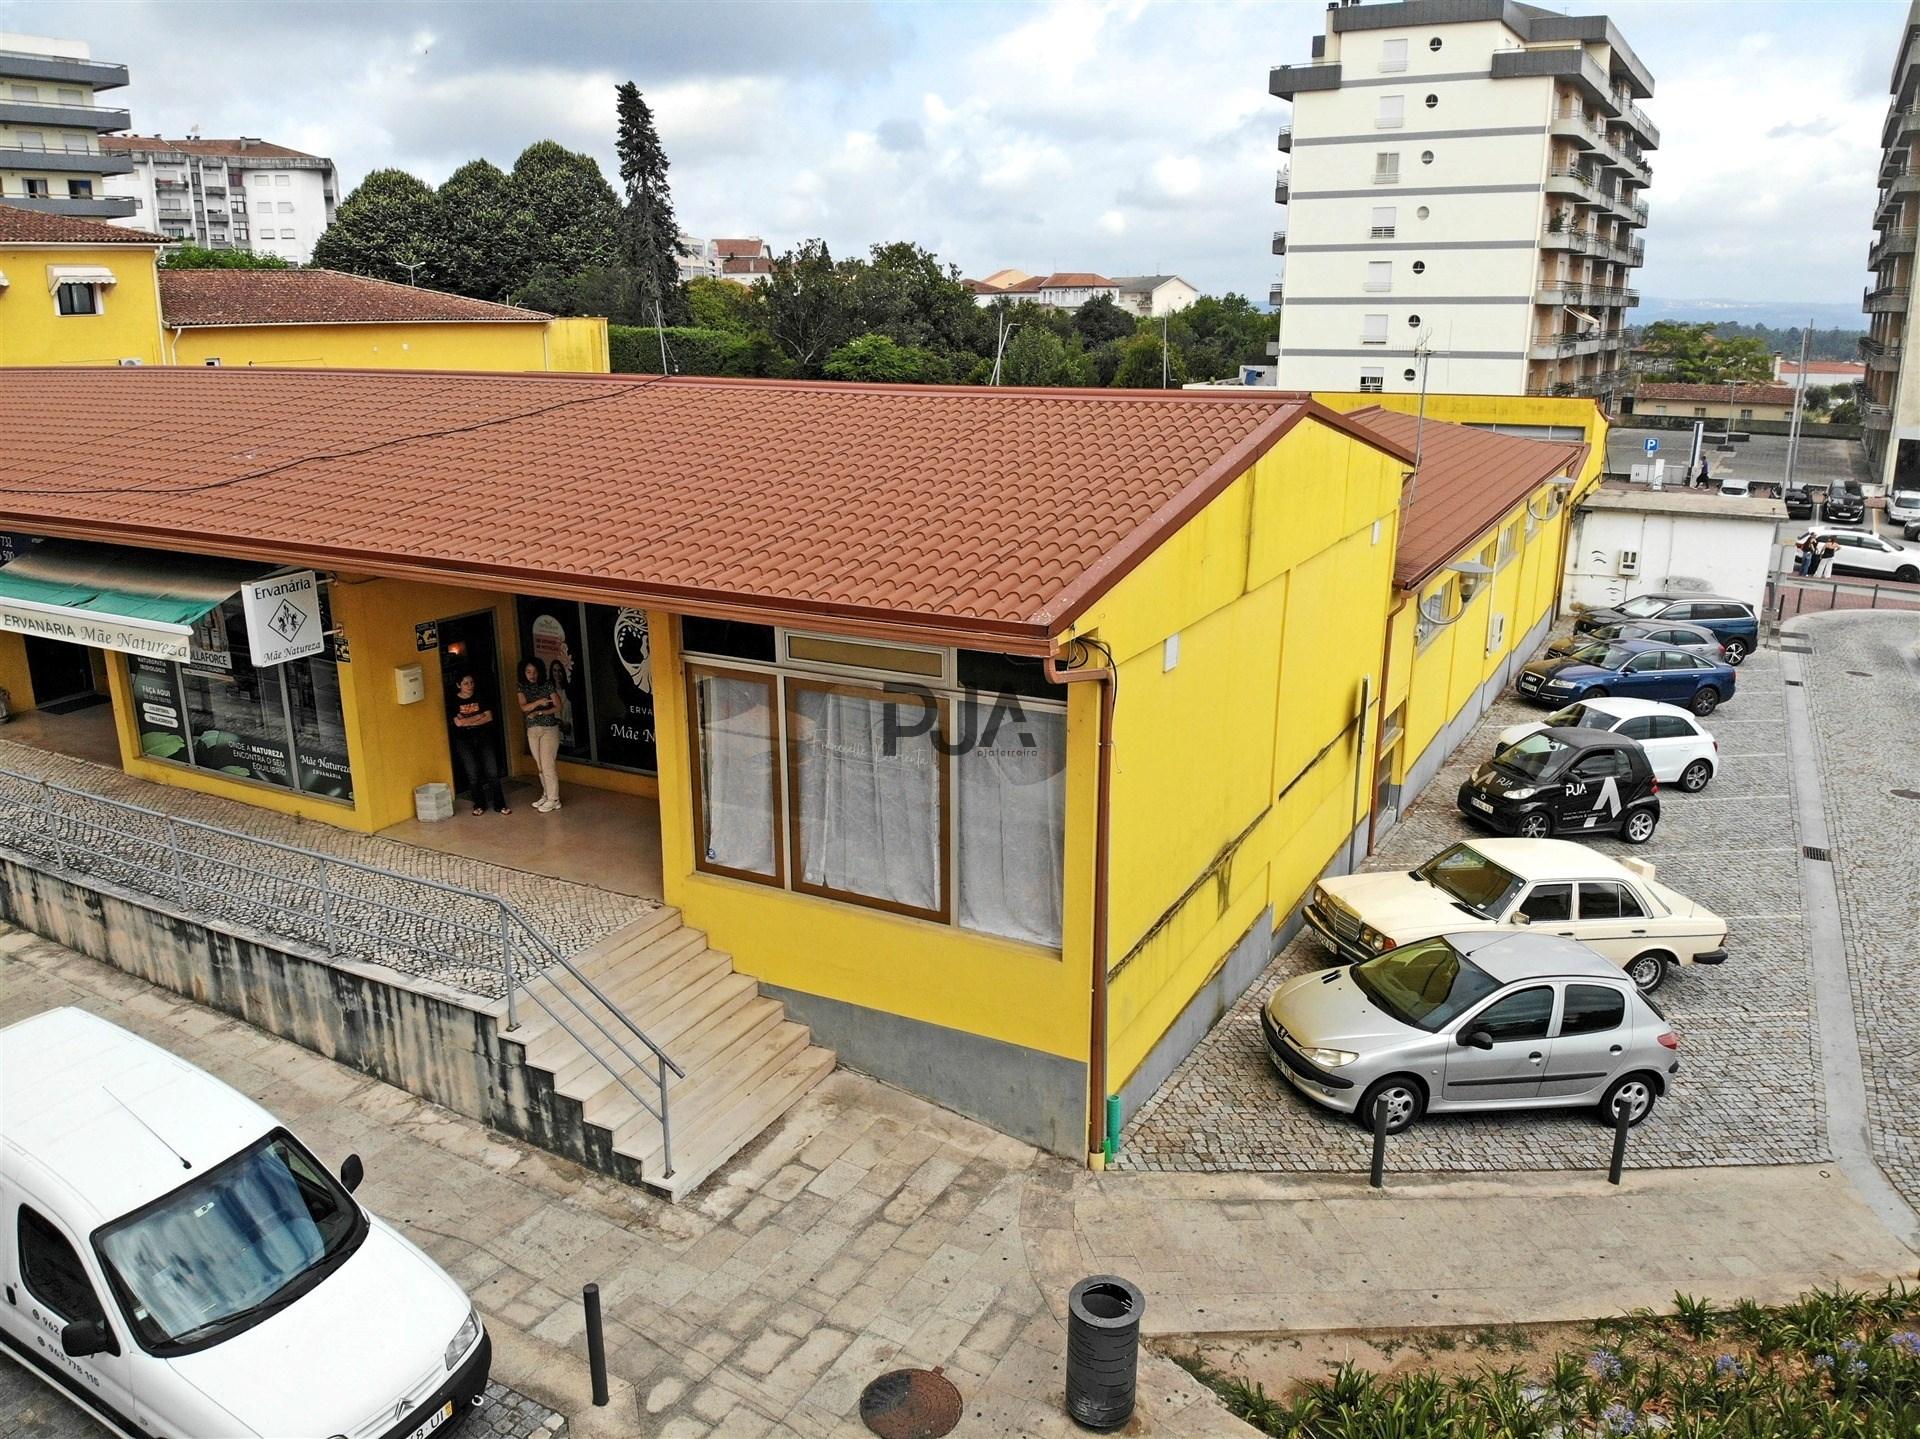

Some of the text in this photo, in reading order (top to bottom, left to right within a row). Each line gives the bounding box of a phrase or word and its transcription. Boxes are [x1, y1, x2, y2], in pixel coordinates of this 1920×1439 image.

[1647, 439, 1657, 449] P
[255, 579, 311, 600] Ervanária
[3, 614, 188, 658] ERVANÁRIA Mãe Natureza
[264, 650, 282, 663] Mãe
[284, 641, 321, 658] Natureza
[630, 705, 653, 716] ERVA
[610, 723, 639, 741] Mãe
[251, 745, 284, 758] NATUREZA
[1566, 783, 1588, 797] PJA
[43, 1317, 60, 1336] 962
